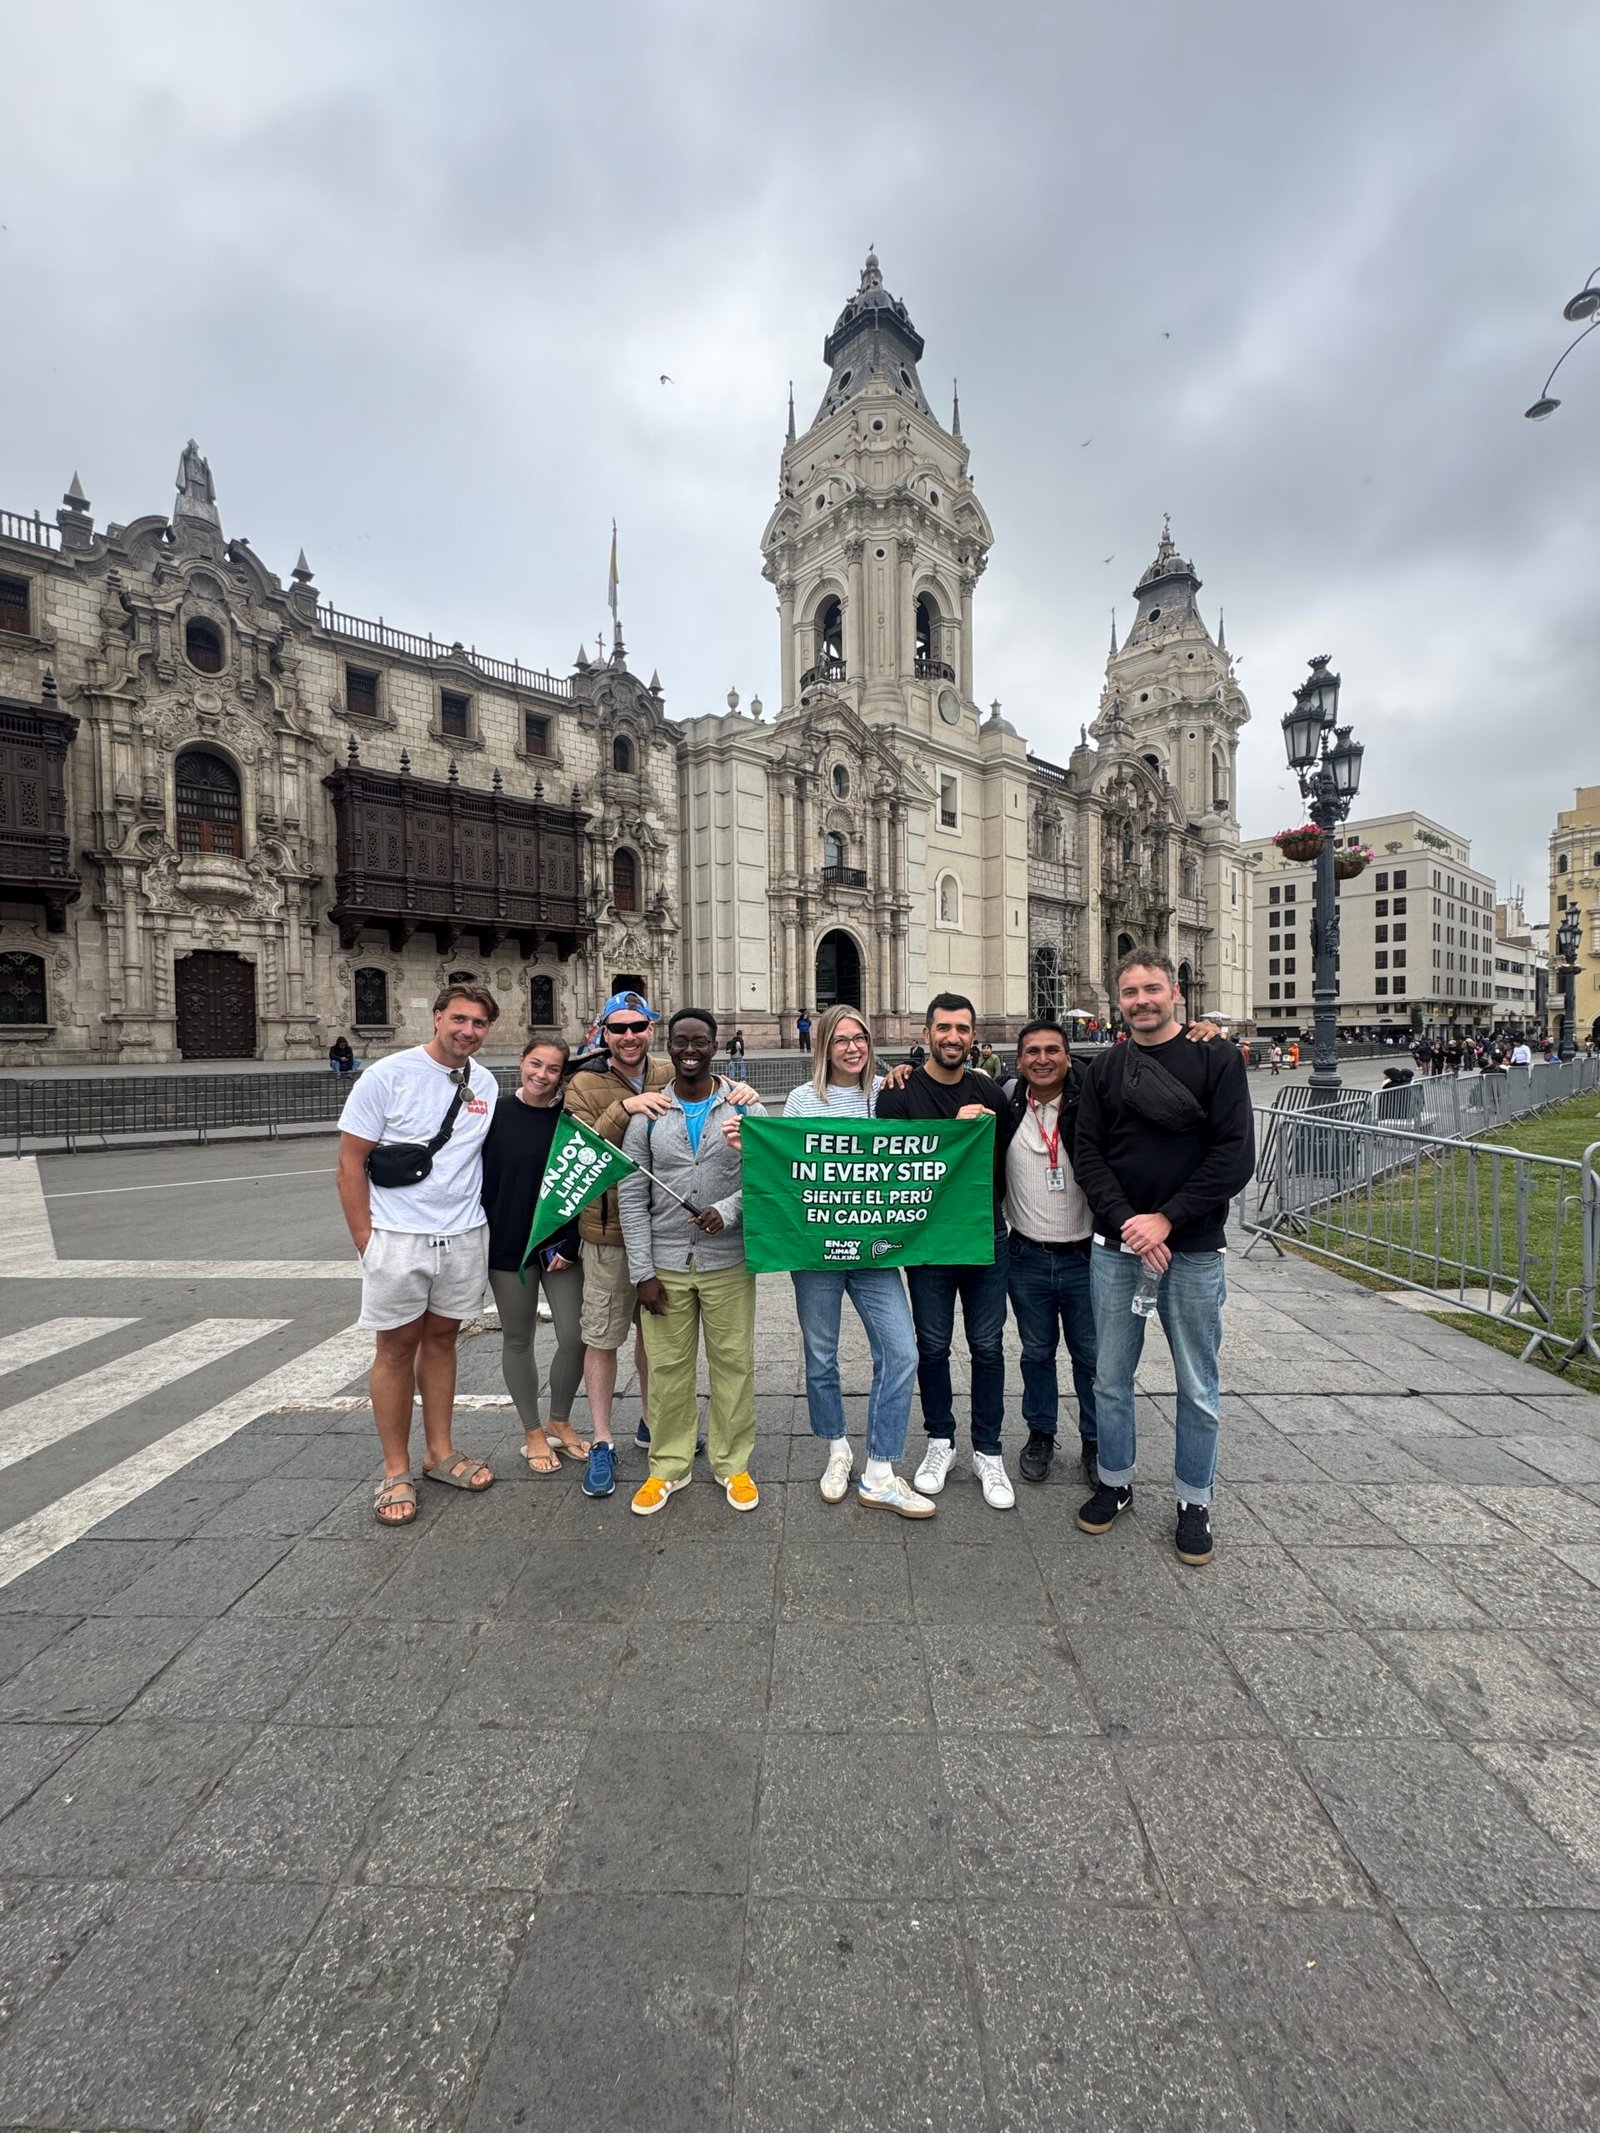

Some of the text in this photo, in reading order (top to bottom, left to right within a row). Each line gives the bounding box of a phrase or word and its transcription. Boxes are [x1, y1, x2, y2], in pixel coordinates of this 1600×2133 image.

[805, 1133, 940, 1155] FEEL PERU
[539, 1130, 587, 1201] ENJOY
[791, 1161, 947, 1182] IN EVERY STEP
[557, 1151, 613, 1218] WALKING
[802, 1187, 933, 1204] SIENTE EL PERÚ
[807, 1208, 928, 1224] EN CADA PASO
[825, 1240, 861, 1248] ENJOY
